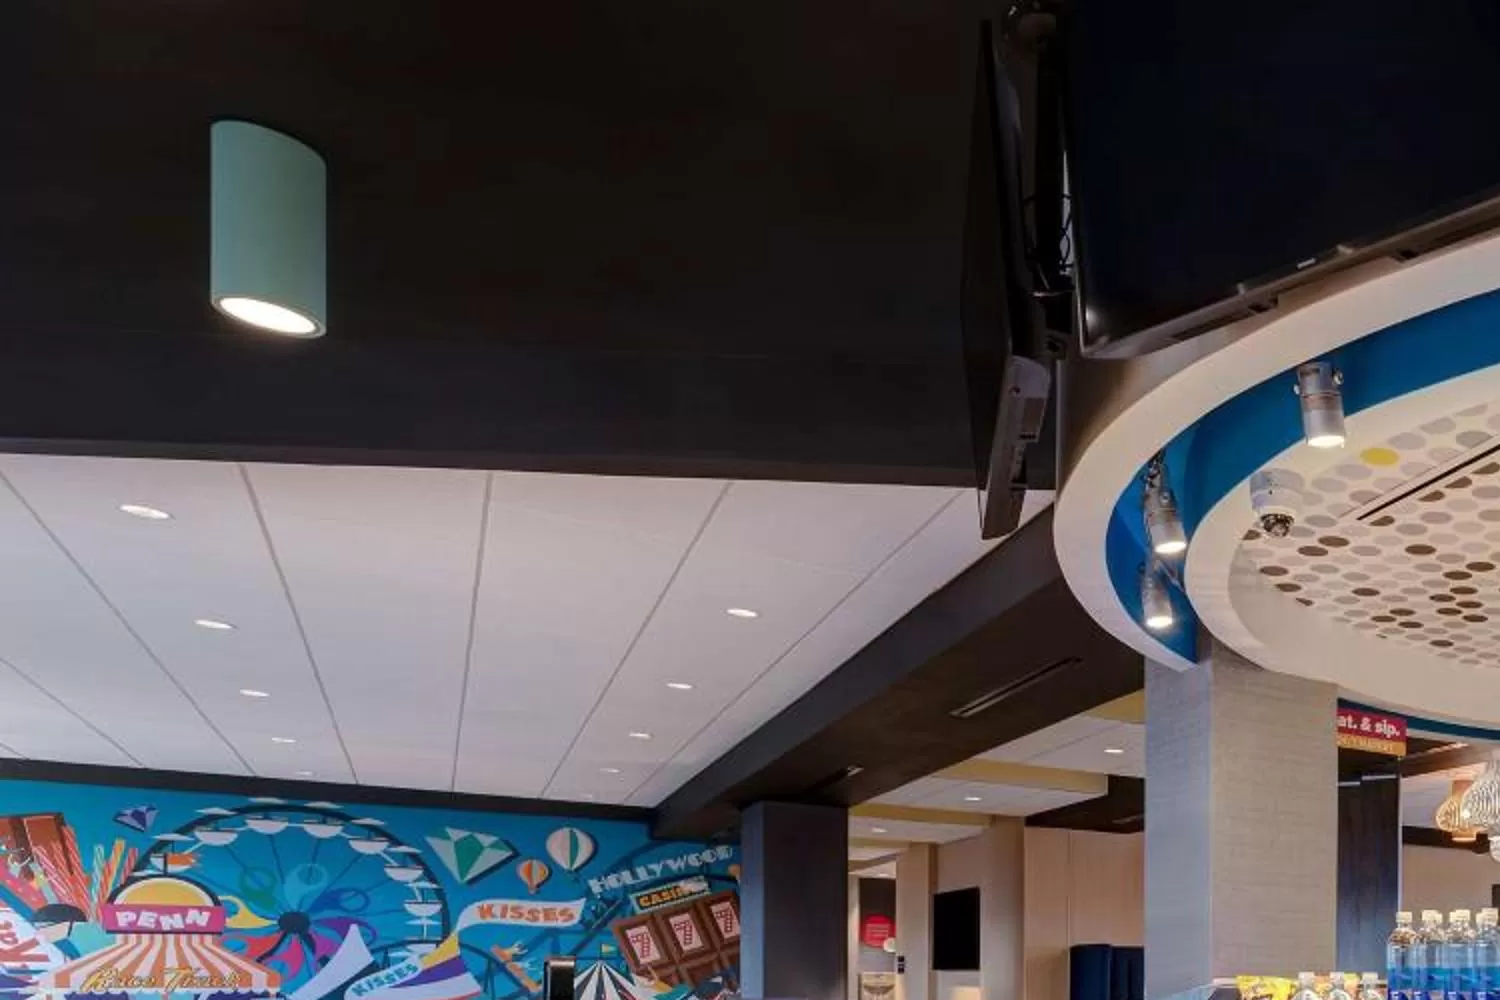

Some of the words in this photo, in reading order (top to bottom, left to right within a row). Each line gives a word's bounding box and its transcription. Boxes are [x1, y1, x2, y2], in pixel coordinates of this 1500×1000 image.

[1361, 716, 1373, 732] &
[1375, 719, 1400, 738] sip.
[588, 845, 733, 894] HOLLYWOOD
[115, 907, 210, 931] PENN
[477, 902, 577, 923] KISSES
[351, 962, 419, 997] KISSES
